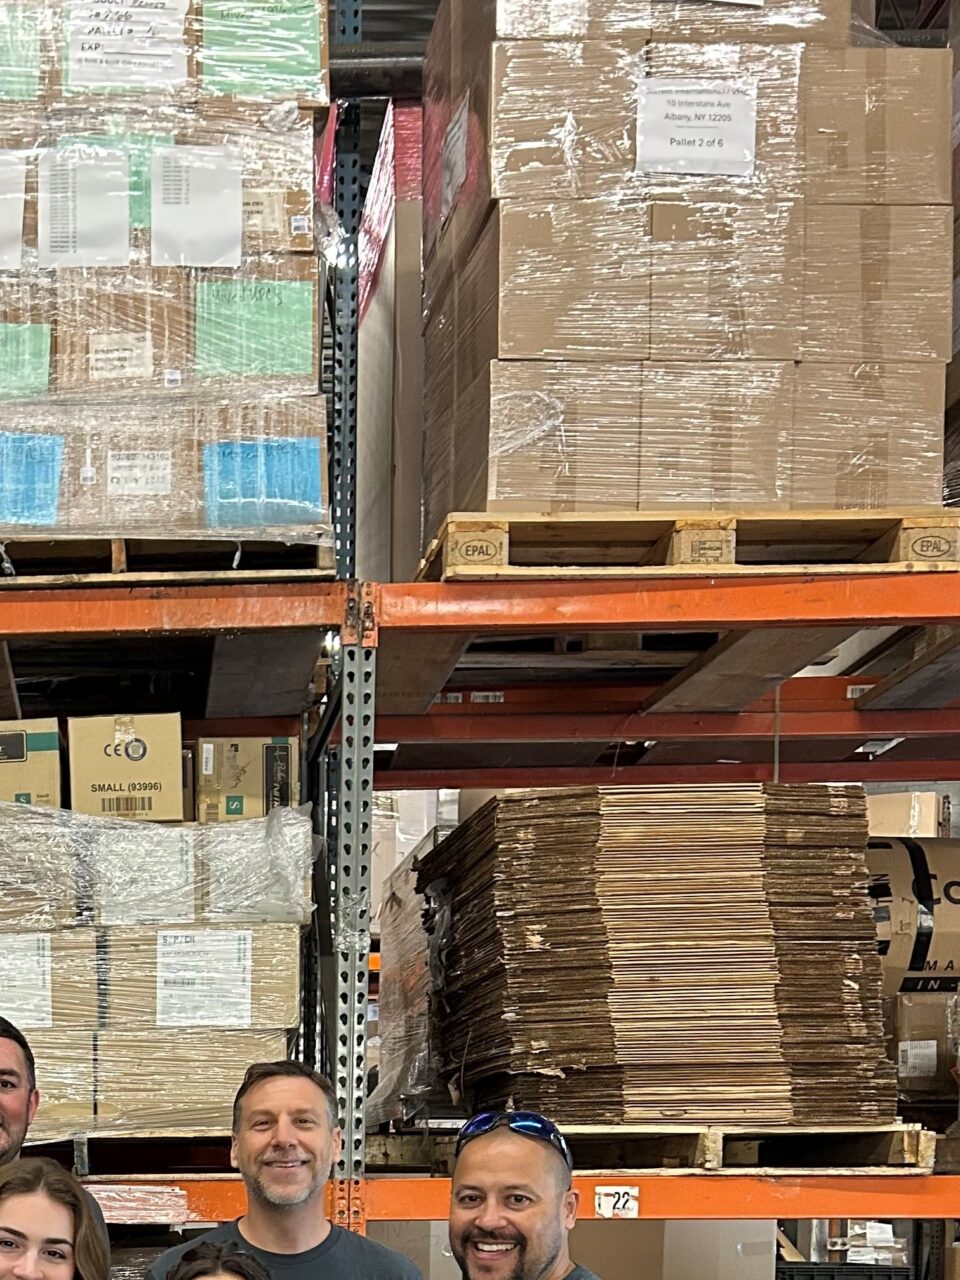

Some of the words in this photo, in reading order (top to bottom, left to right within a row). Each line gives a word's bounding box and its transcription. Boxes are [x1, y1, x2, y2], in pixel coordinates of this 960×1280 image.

[678, 99, 715, 108] Interstate
[717, 100, 732, 108] Ave
[664, 112, 693, 122] Albany,
[709, 114, 733, 122] 12205
[670, 137, 696, 147] Pallet
[699, 138, 704, 147] 2
[706, 139, 716, 147] of
[718, 139, 724, 147] 6
[465, 544, 492, 557] EPAL
[920, 540, 945, 553] EPAL
[90, 783, 126, 793] SMALL
[127, 782, 163, 793] (93996)
